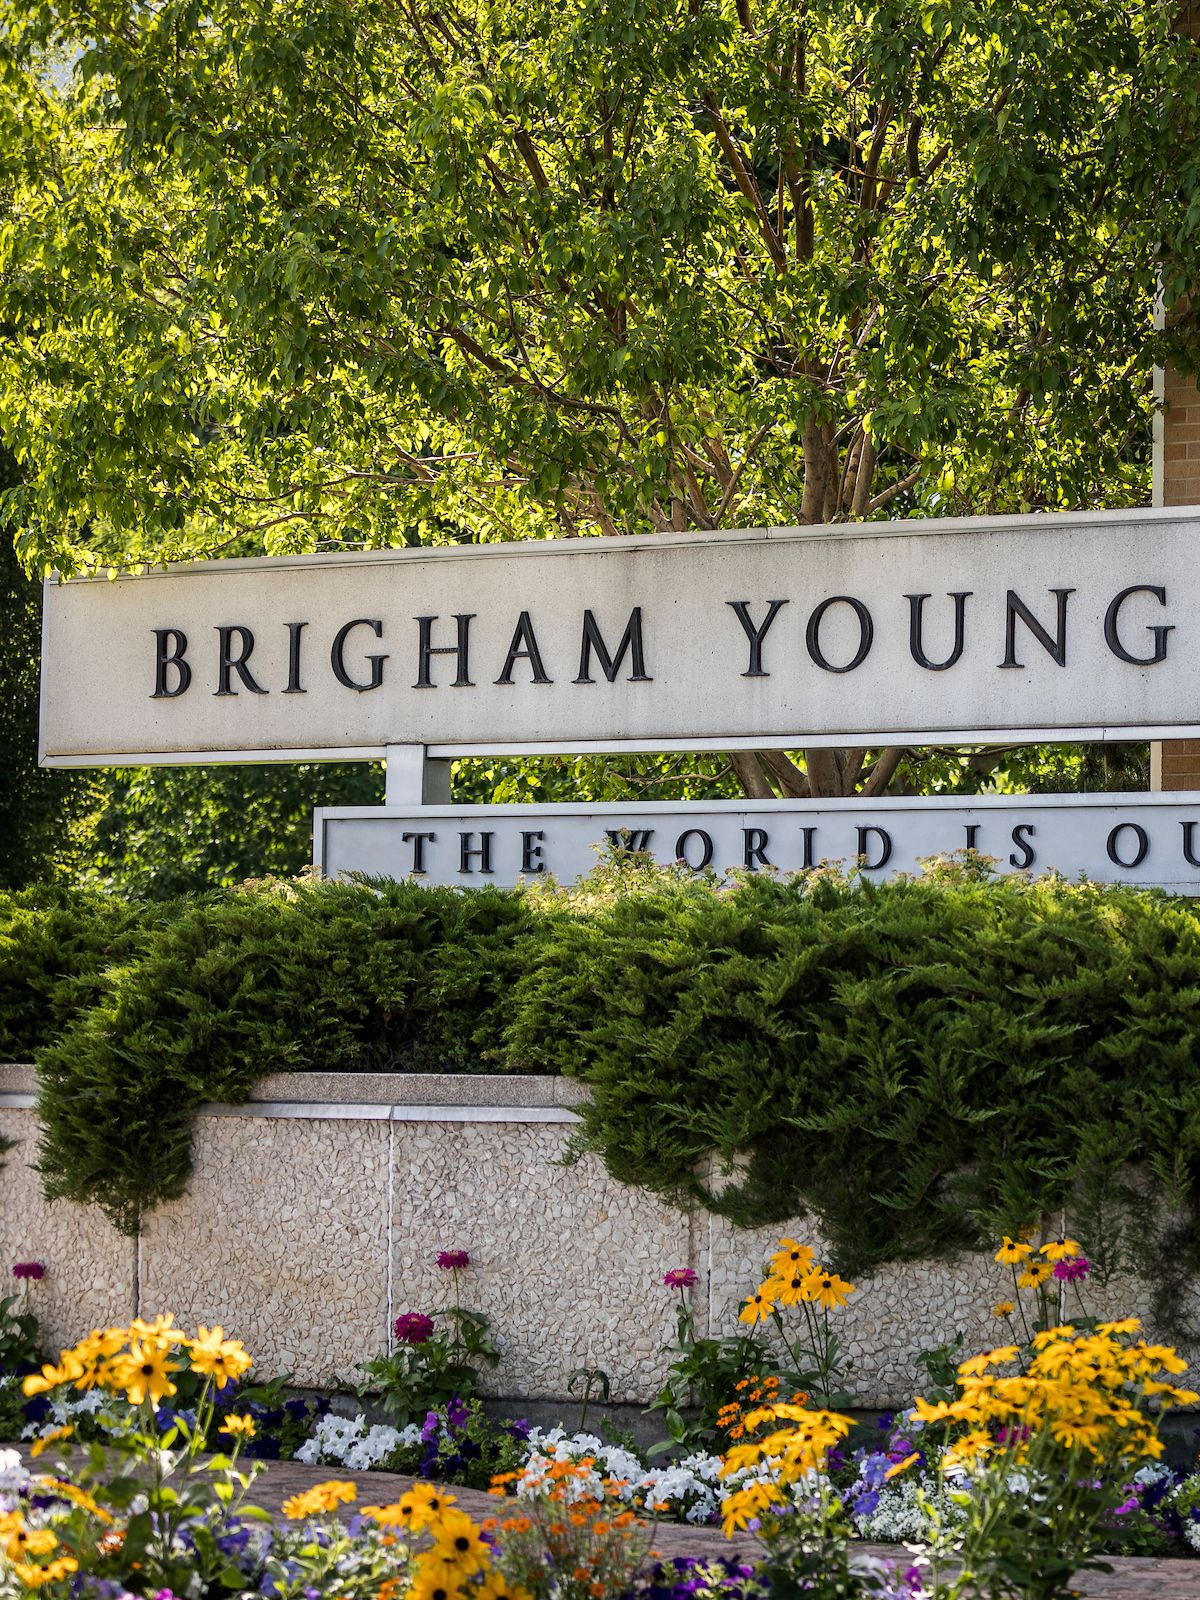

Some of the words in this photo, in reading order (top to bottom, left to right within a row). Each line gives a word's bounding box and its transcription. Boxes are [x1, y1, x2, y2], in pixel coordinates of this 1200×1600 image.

[150, 607, 653, 698] BRIGHAM
[726, 585, 1176, 677] YOUNG
[402, 830, 545, 874] THE
[963, 824, 1036, 869] IS
